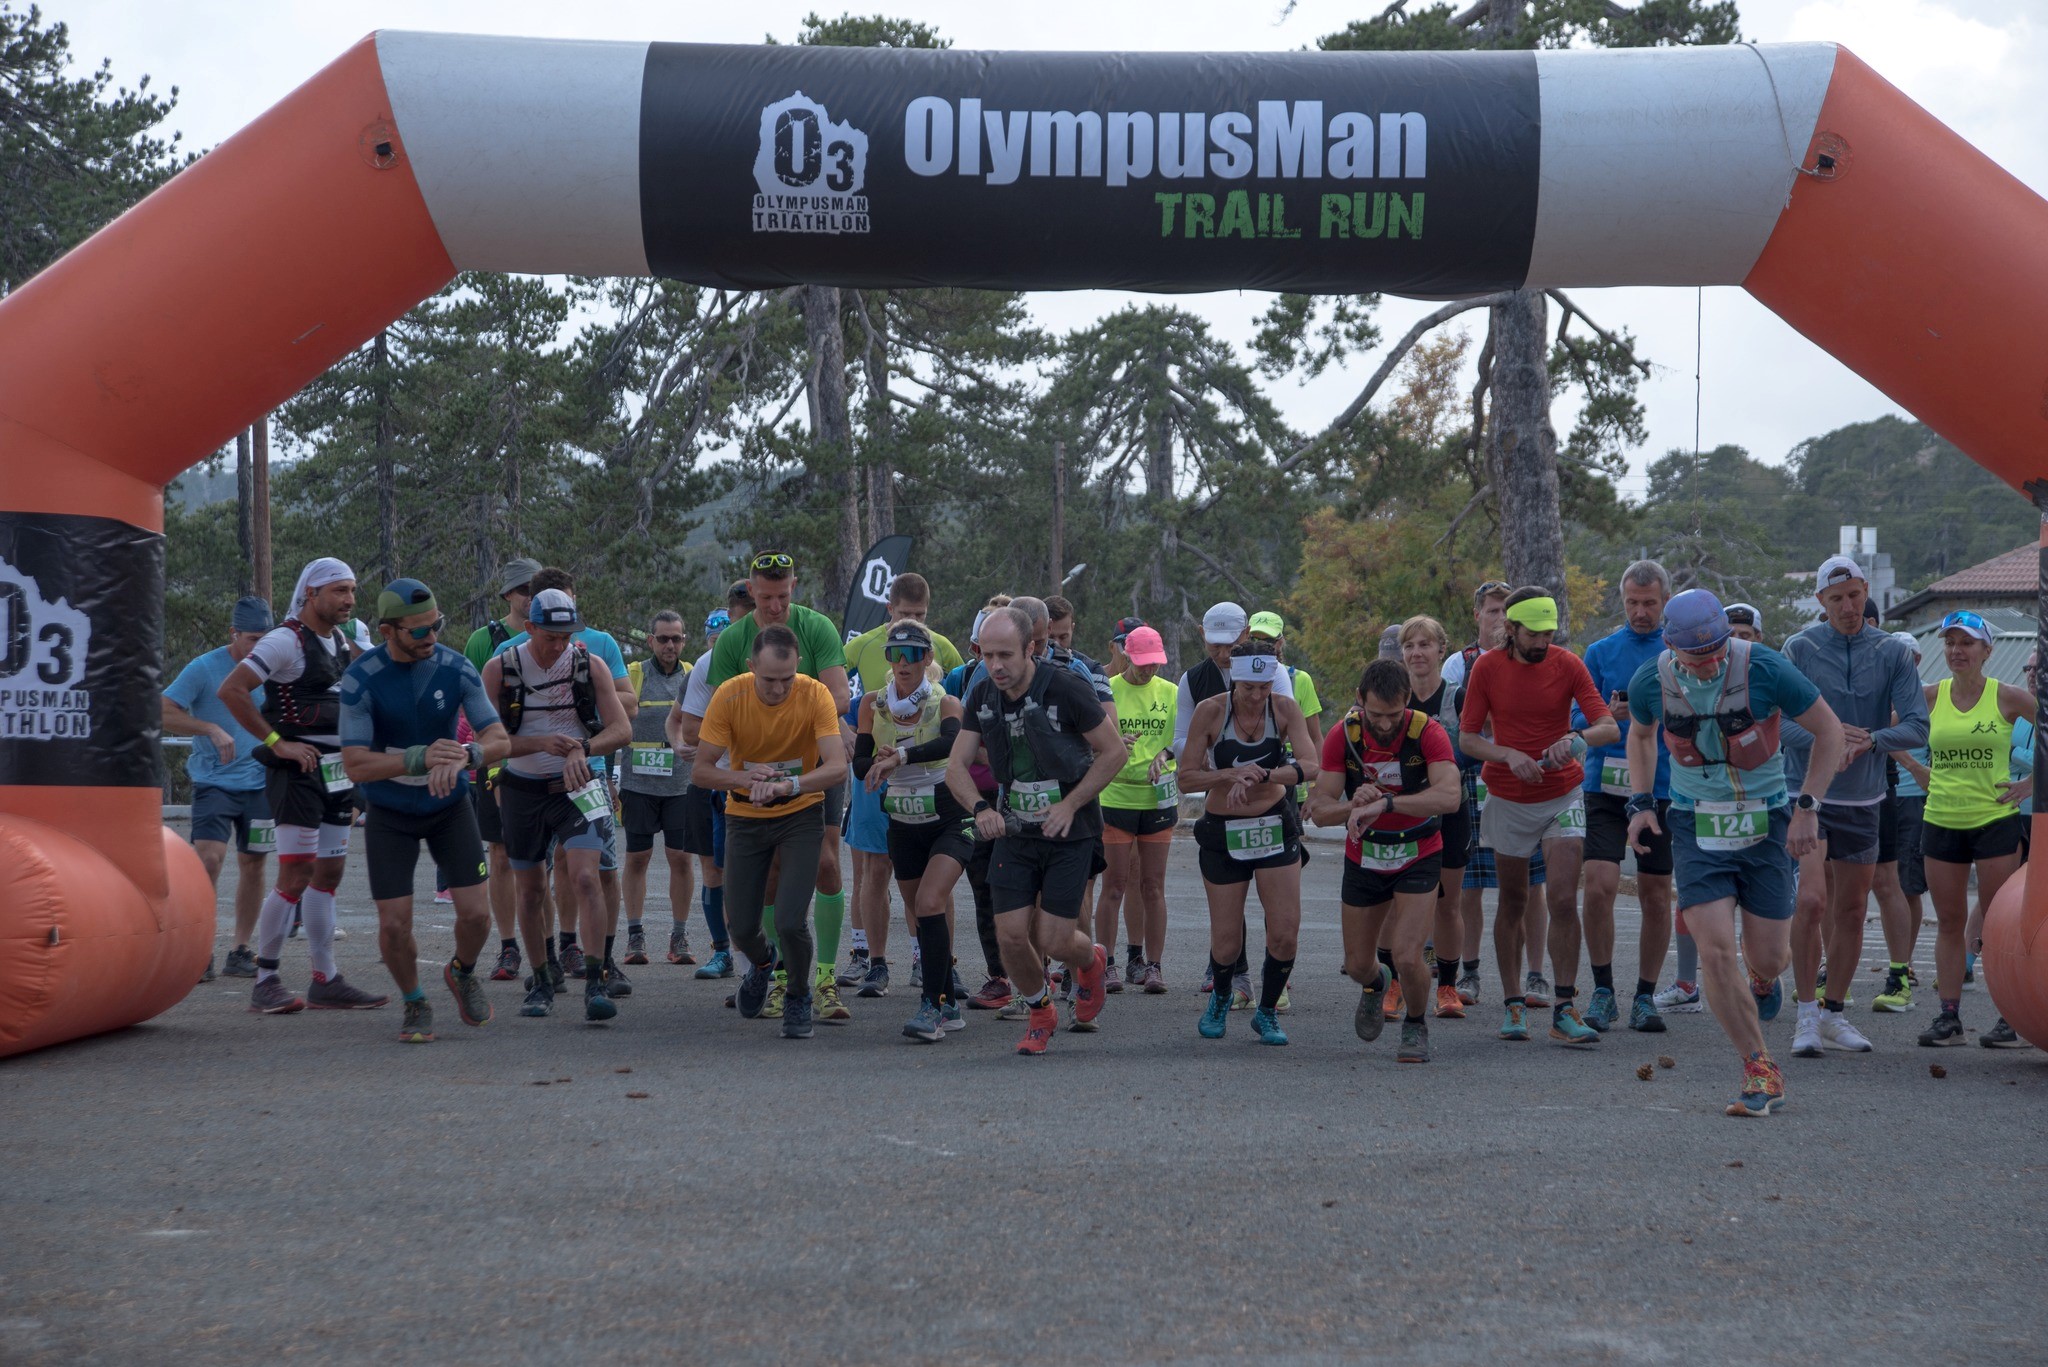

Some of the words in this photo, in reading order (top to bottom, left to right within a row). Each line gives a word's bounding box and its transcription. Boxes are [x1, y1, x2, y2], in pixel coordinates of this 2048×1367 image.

[904, 96, 1428, 187] OlympusMan
[756, 195, 867, 211] OLYMPUSMAN
[754, 212, 869, 232] TRIATHLON
[1155, 190, 1302, 240] TRAIL
[1319, 192, 1426, 240] RUN
[1120, 719, 1167, 729] PAPHOS
[640, 752, 665, 766] 134
[1970, 761, 1994, 769] CLUB
[328, 763, 349, 780] 10
[584, 788, 606, 808] 10
[1163, 783, 1177, 798] 15
[894, 797, 925, 815] 106
[1018, 793, 1052, 812] 128
[1567, 810, 1587, 827] 10
[1710, 813, 1756, 837] 124
[1238, 828, 1273, 848] 156
[1373, 842, 1408, 860] 132
